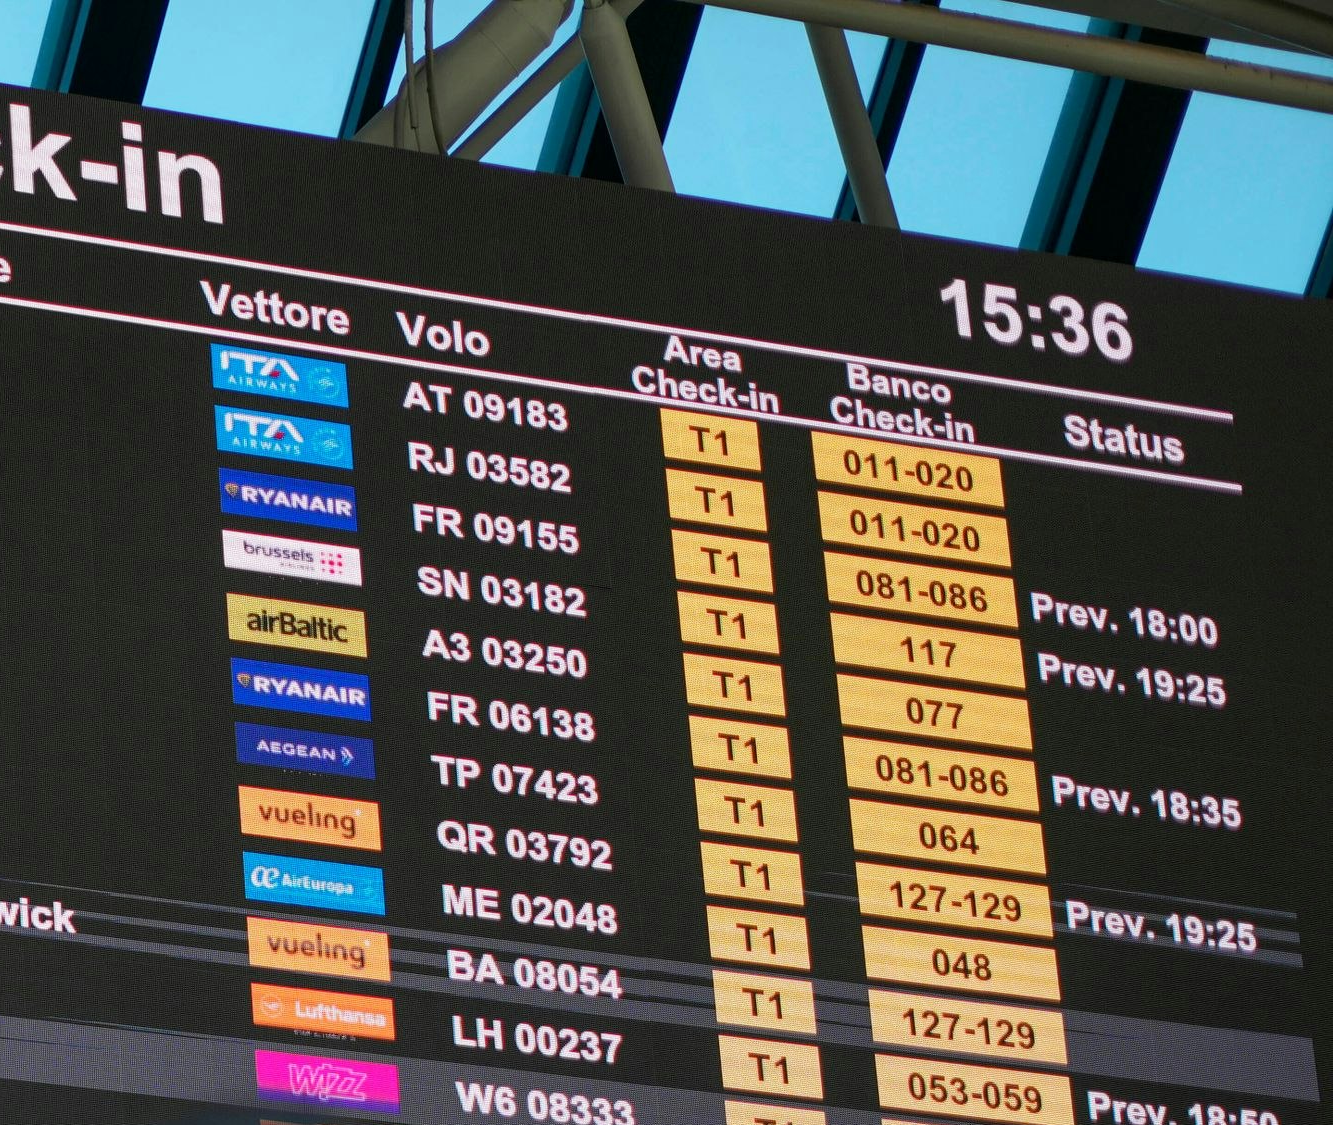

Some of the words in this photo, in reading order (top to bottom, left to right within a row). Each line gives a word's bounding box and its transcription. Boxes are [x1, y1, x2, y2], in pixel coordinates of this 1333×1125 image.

[200, 280, 350, 336] Vettore
[940, 278, 1133, 361] 15:36
[396, 311, 490, 357] Volo
[662, 334, 743, 373] Area
[630, 365, 780, 414] Check-in
[846, 362, 953, 405] Banco
[829, 396, 976, 444] Check-in
[1064, 414, 1185, 463] Status
[408, 441, 455, 476] RJ
[466, 450, 572, 494] 03582
[842, 448, 975, 493] 011-020
[240, 485, 353, 517] RYANAIR
[242, 540, 314, 563] brussels
[246, 610, 348, 644] airBaltic
[1031, 592, 1119, 632] Prev.
[1129, 607, 1218, 646] 18:00
[900, 635, 958, 668] 117
[427, 691, 479, 727] FR
[488, 700, 596, 743] 06138
[256, 739, 337, 762] AEGEAN
[258, 802, 357, 840] vueling
[1052, 775, 1142, 815] Prev.
[1151, 789, 1242, 828] 18:35
[917, 820, 981, 856] 064
[729, 858, 772, 892] T1
[446, 949, 504, 986] BA
[512, 957, 623, 1000] 08054
[930, 947, 994, 982] 048
